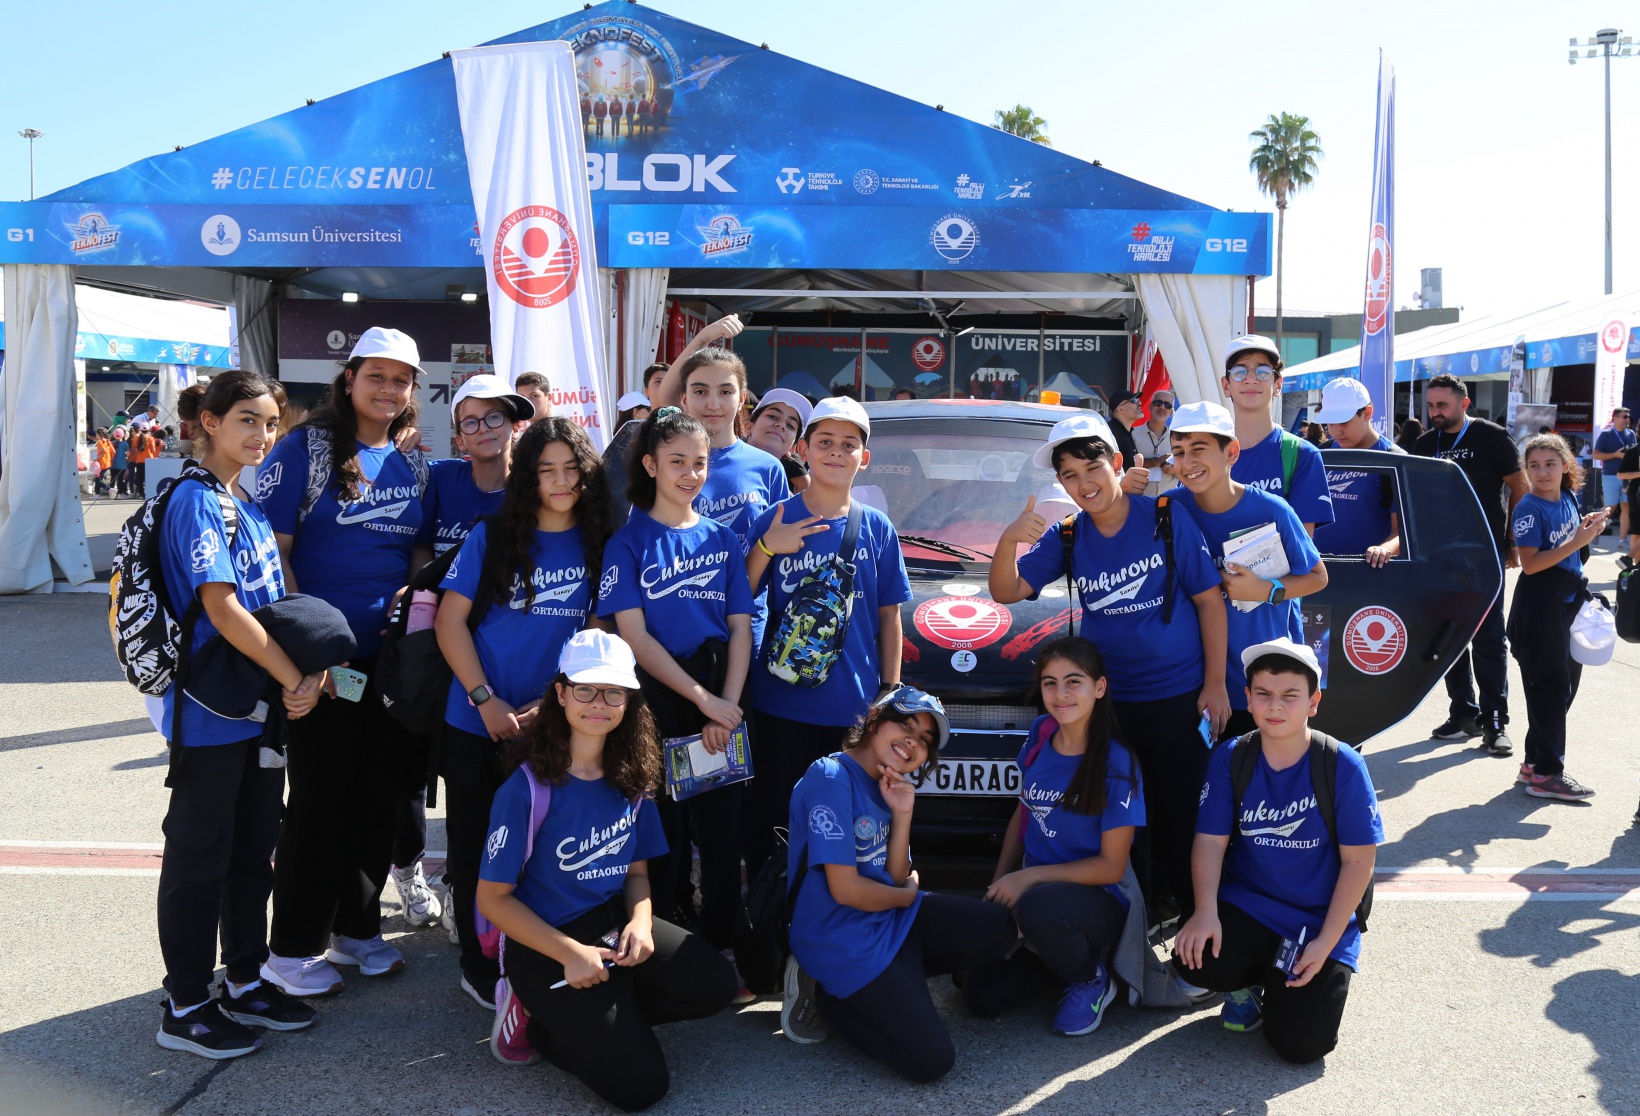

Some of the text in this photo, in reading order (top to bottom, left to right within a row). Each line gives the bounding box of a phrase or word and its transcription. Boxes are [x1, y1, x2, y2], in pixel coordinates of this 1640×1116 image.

[571, 26, 665, 63] EKNOFEST
[211, 166, 437, 190] #GELECEKSENOL
[585, 152, 738, 193] BLOK
[7, 228, 34, 242] G1
[72, 231, 119, 251] TEKNOFEST
[247, 225, 402, 243] Samsun Üniversitesi
[627, 231, 670, 245] G12
[702, 234, 752, 254] TEKNOFEST
[1205, 238, 1248, 253] G12
[971, 335, 1101, 351] ÜNİVERSİTESİ
[870, 462, 911, 474] sparco
[1031, 470, 1056, 481] spar
[123, 592, 149, 610] NIKE
[1103, 596, 1164, 616] ORTAOKULU
[951, 641, 973, 649] 2008
[935, 763, 1020, 791] GARAG
[1253, 836, 1321, 849] ORTAOKULU
